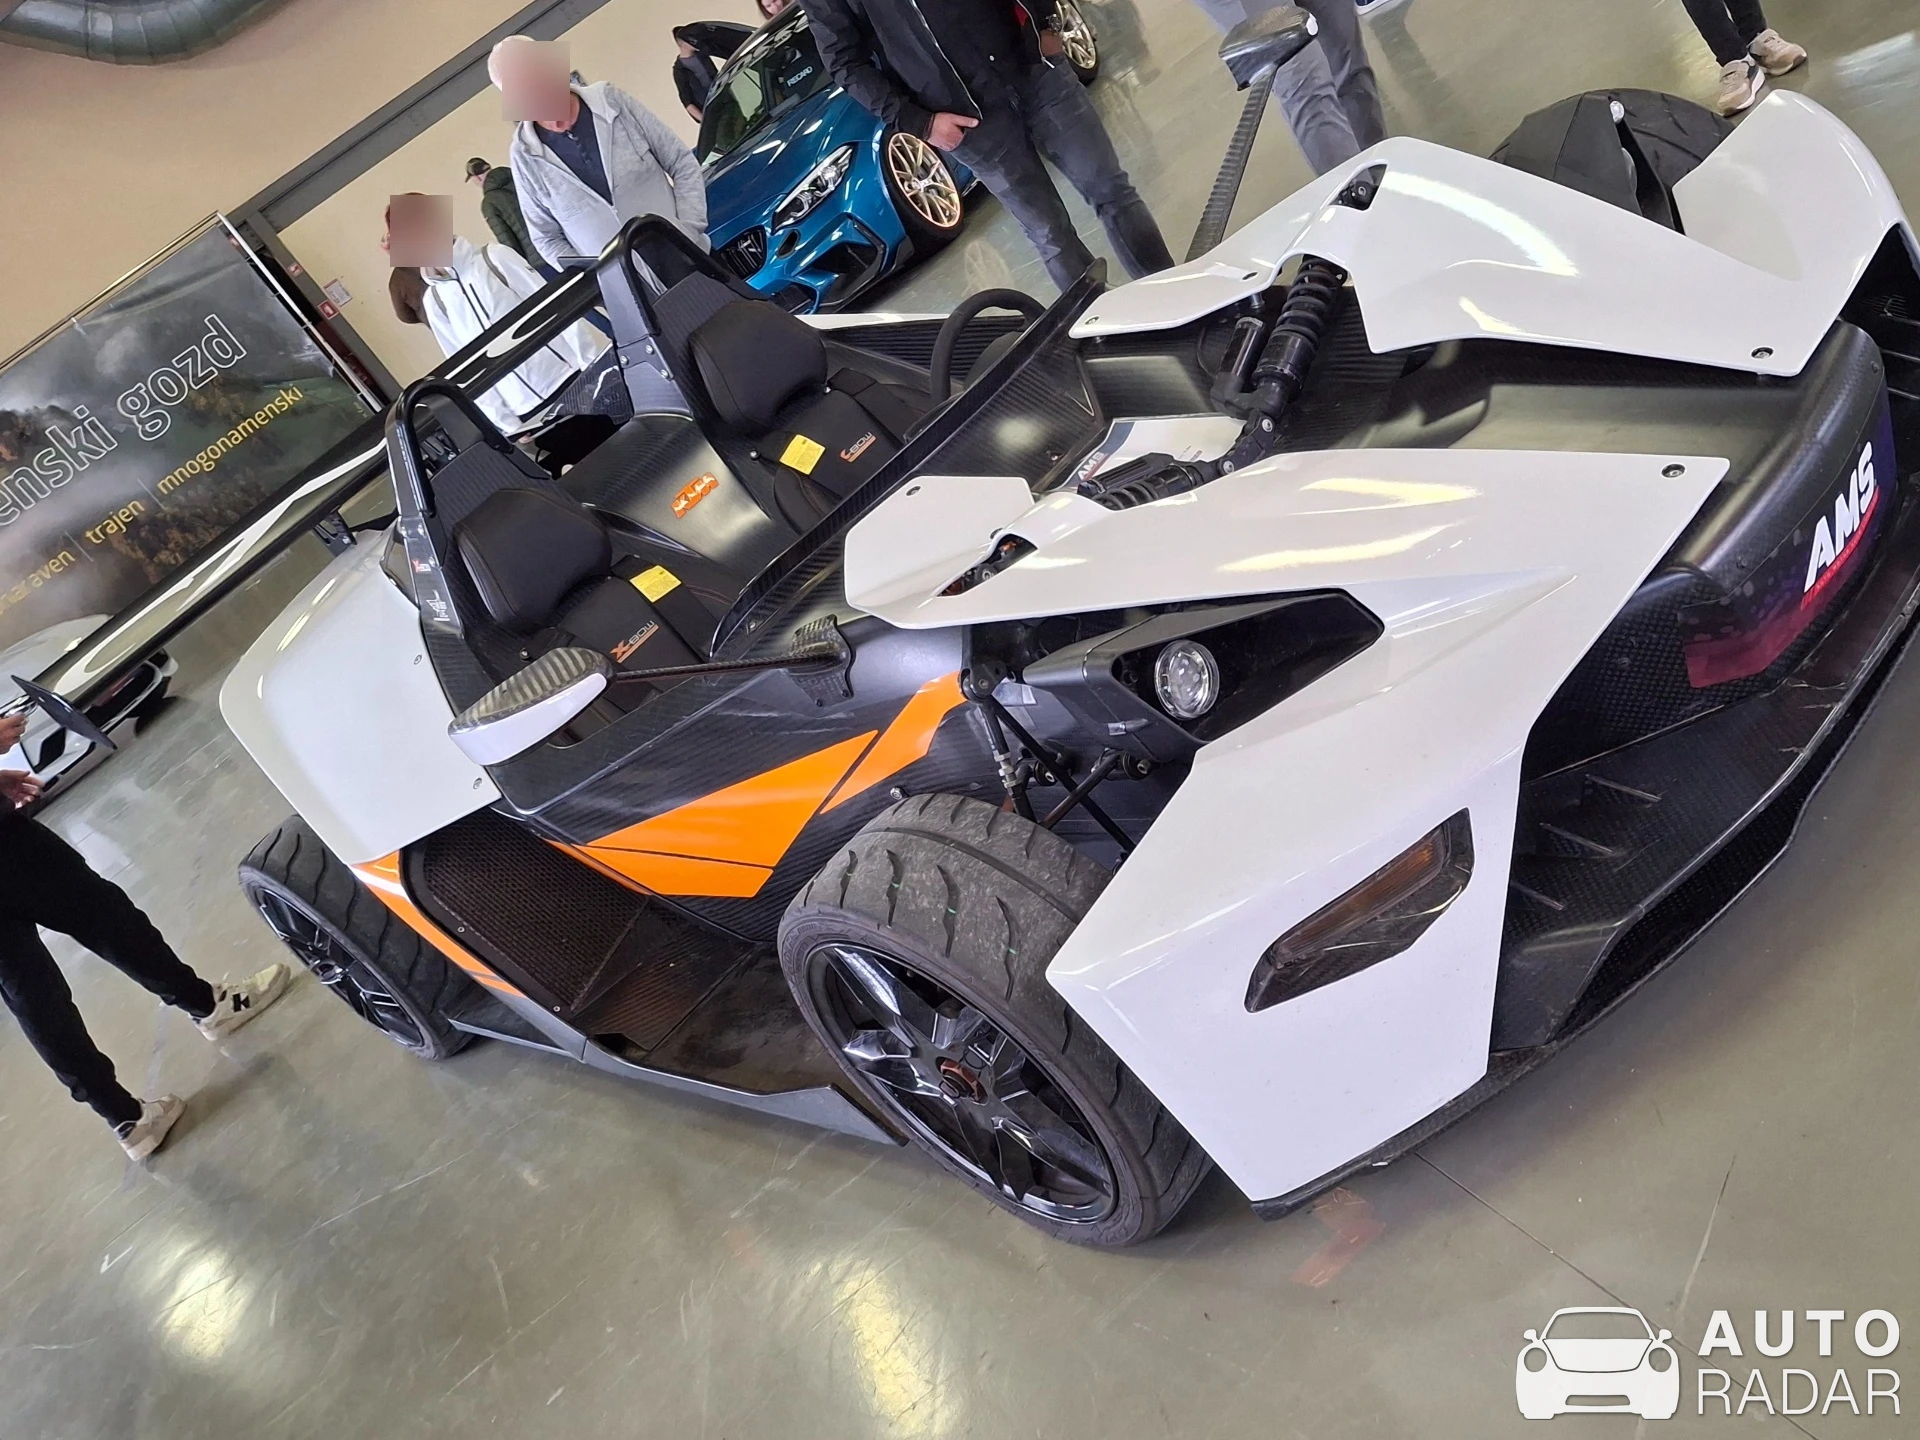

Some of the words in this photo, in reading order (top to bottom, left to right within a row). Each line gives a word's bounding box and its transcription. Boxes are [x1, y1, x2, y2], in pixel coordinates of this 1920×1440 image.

[117, 314, 247, 441] gozd
[85, 500, 145, 544] trajen
[156, 384, 304, 496] mnogonamenski
[1804, 441, 1875, 593] AMS
